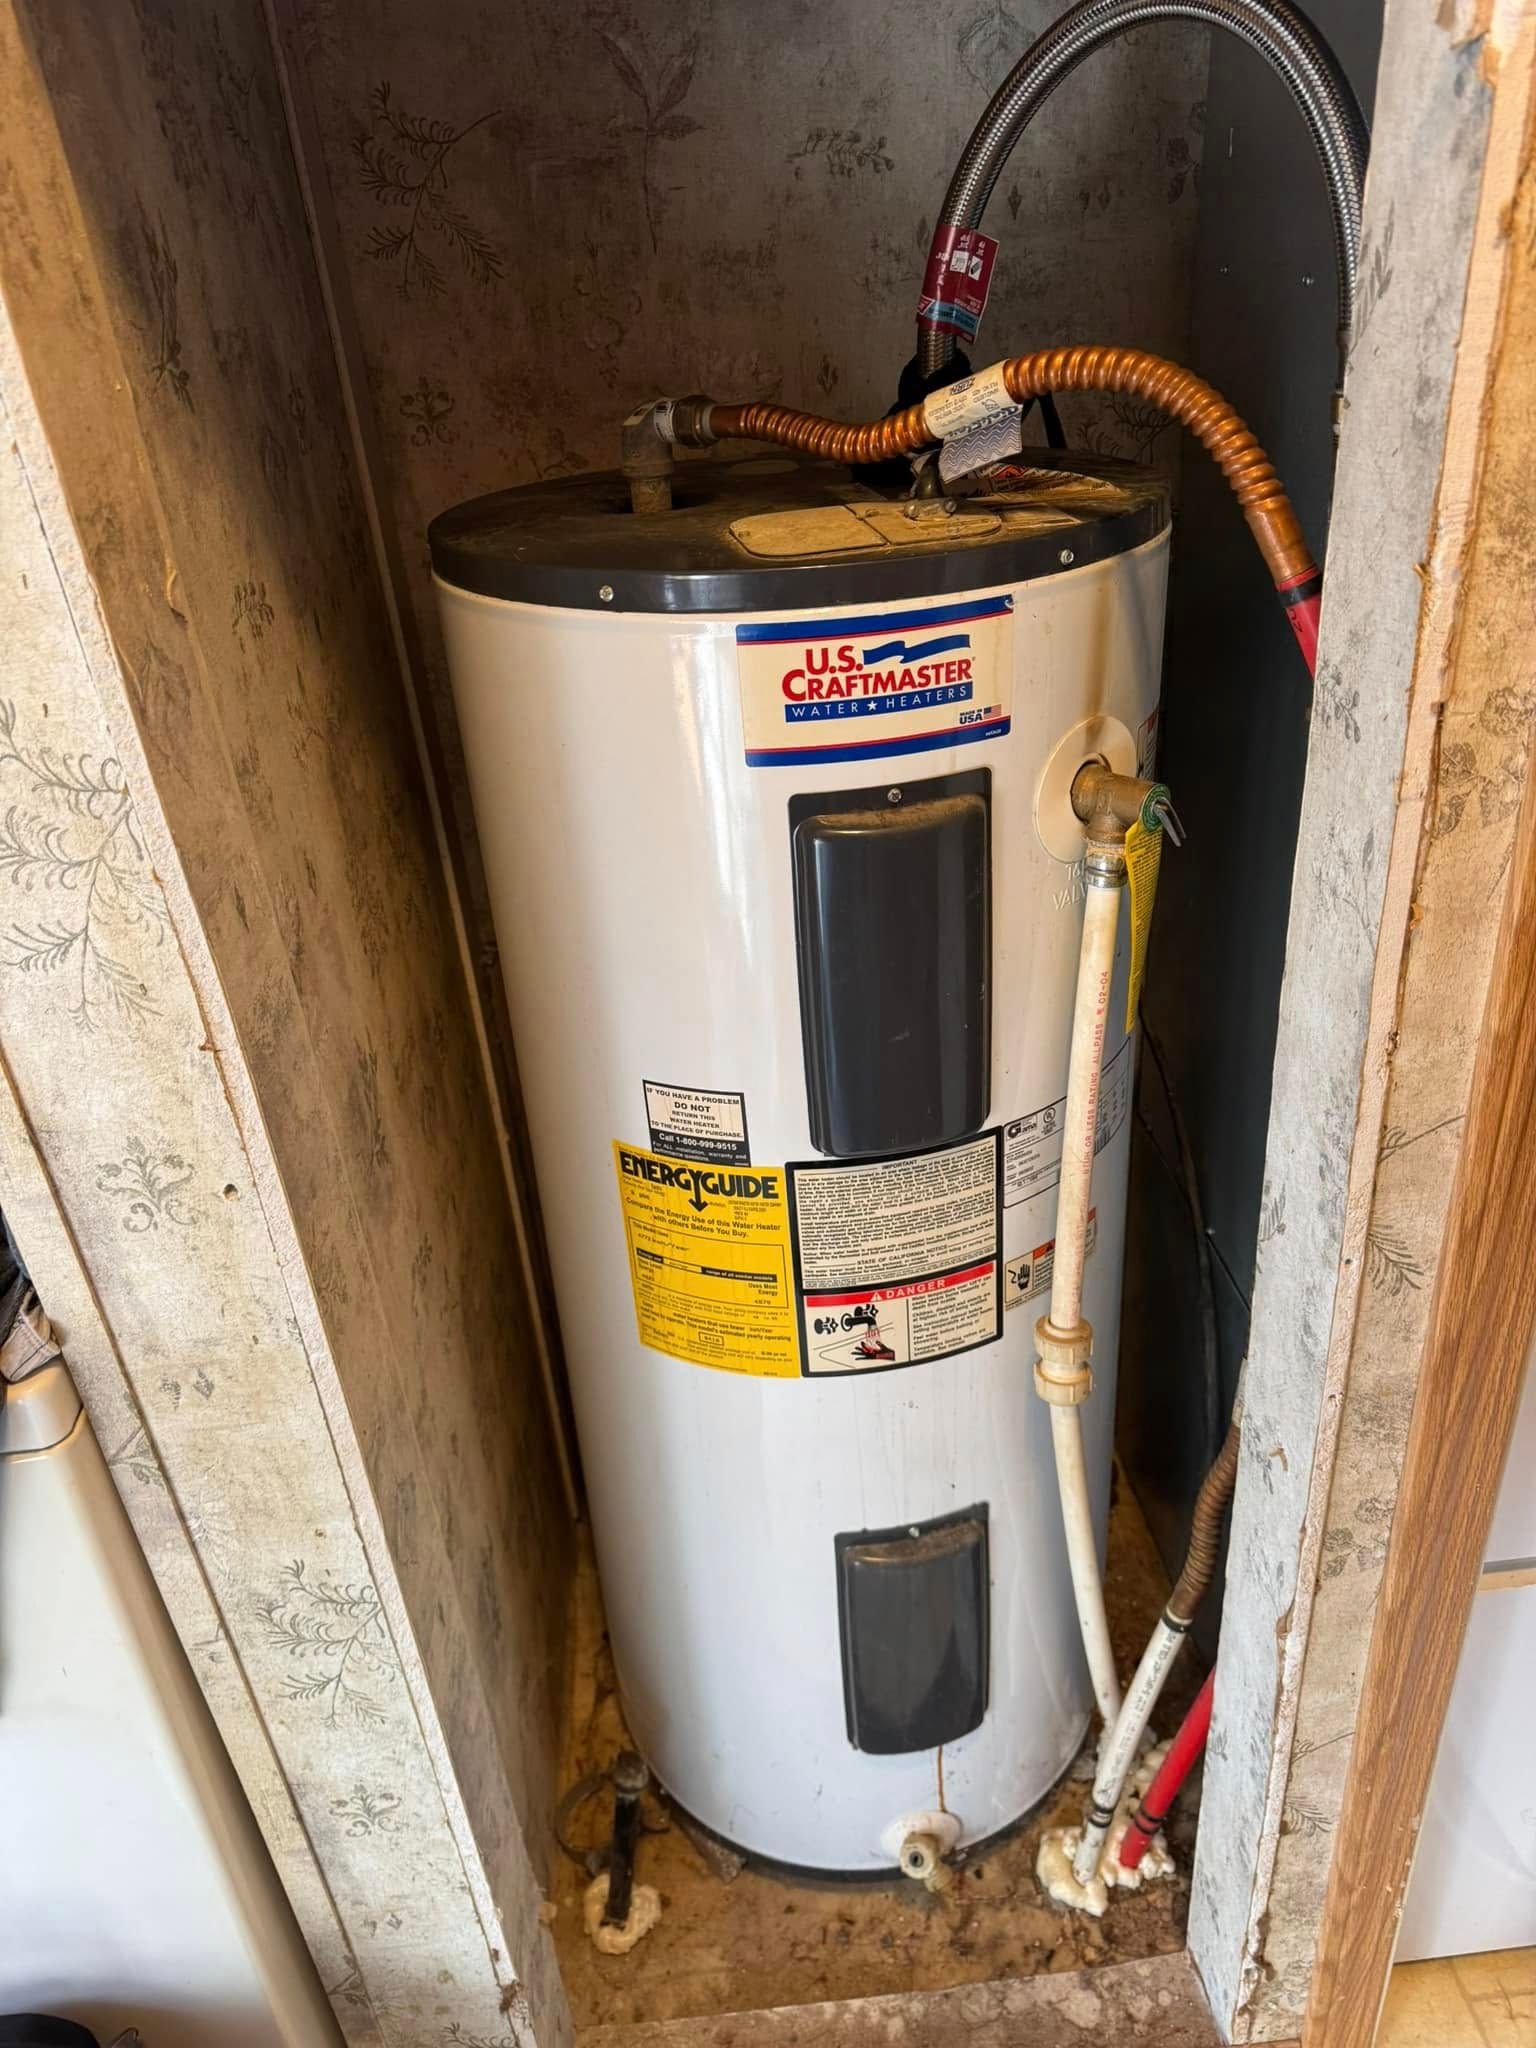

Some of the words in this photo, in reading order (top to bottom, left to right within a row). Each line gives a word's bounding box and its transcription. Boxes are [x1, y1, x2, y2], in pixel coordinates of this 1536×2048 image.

[805, 645, 864, 675] U.S.
[781, 658, 972, 702] CRAFTMASTER
[791, 700, 859, 717] WATER
[886, 686, 967, 709] HEATERS
[960, 713, 982, 725] USA
[1089, 1072, 1098, 1105] RATING
[655, 1089, 670, 1097] YOU
[672, 1092, 692, 1100] HAVE
[702, 1097, 739, 1105] PROBLEM
[672, 1110, 698, 1119] RETURN
[674, 1101, 687, 1109] DO
[691, 1104, 711, 1113] NOT
[669, 1117, 692, 1126] WATER
[1087, 1110, 1095, 1131] LESS
[674, 1125, 694, 1133] PLACE
[659, 1133, 674, 1142] Call
[1085, 1135, 1092, 1147] OR
[882, 1159, 917, 1170] IMPORTANT
[619, 1151, 779, 1212] ENERGYGUIDE
[653, 1214, 666, 1223] with
[668, 1218, 689, 1229] others
[691, 1223, 715, 1233] Before
[717, 1227, 730, 1235] You
[654, 1205, 665, 1214] the
[666, 1208, 690, 1221] Energy
[692, 1215, 705, 1224] Use
[717, 1219, 730, 1227] this
[732, 1222, 754, 1230] Water
[756, 1223, 780, 1231] Heater
[889, 1250, 924, 1261] CALIFORNIA
[886, 1279, 945, 1299] DANGER
